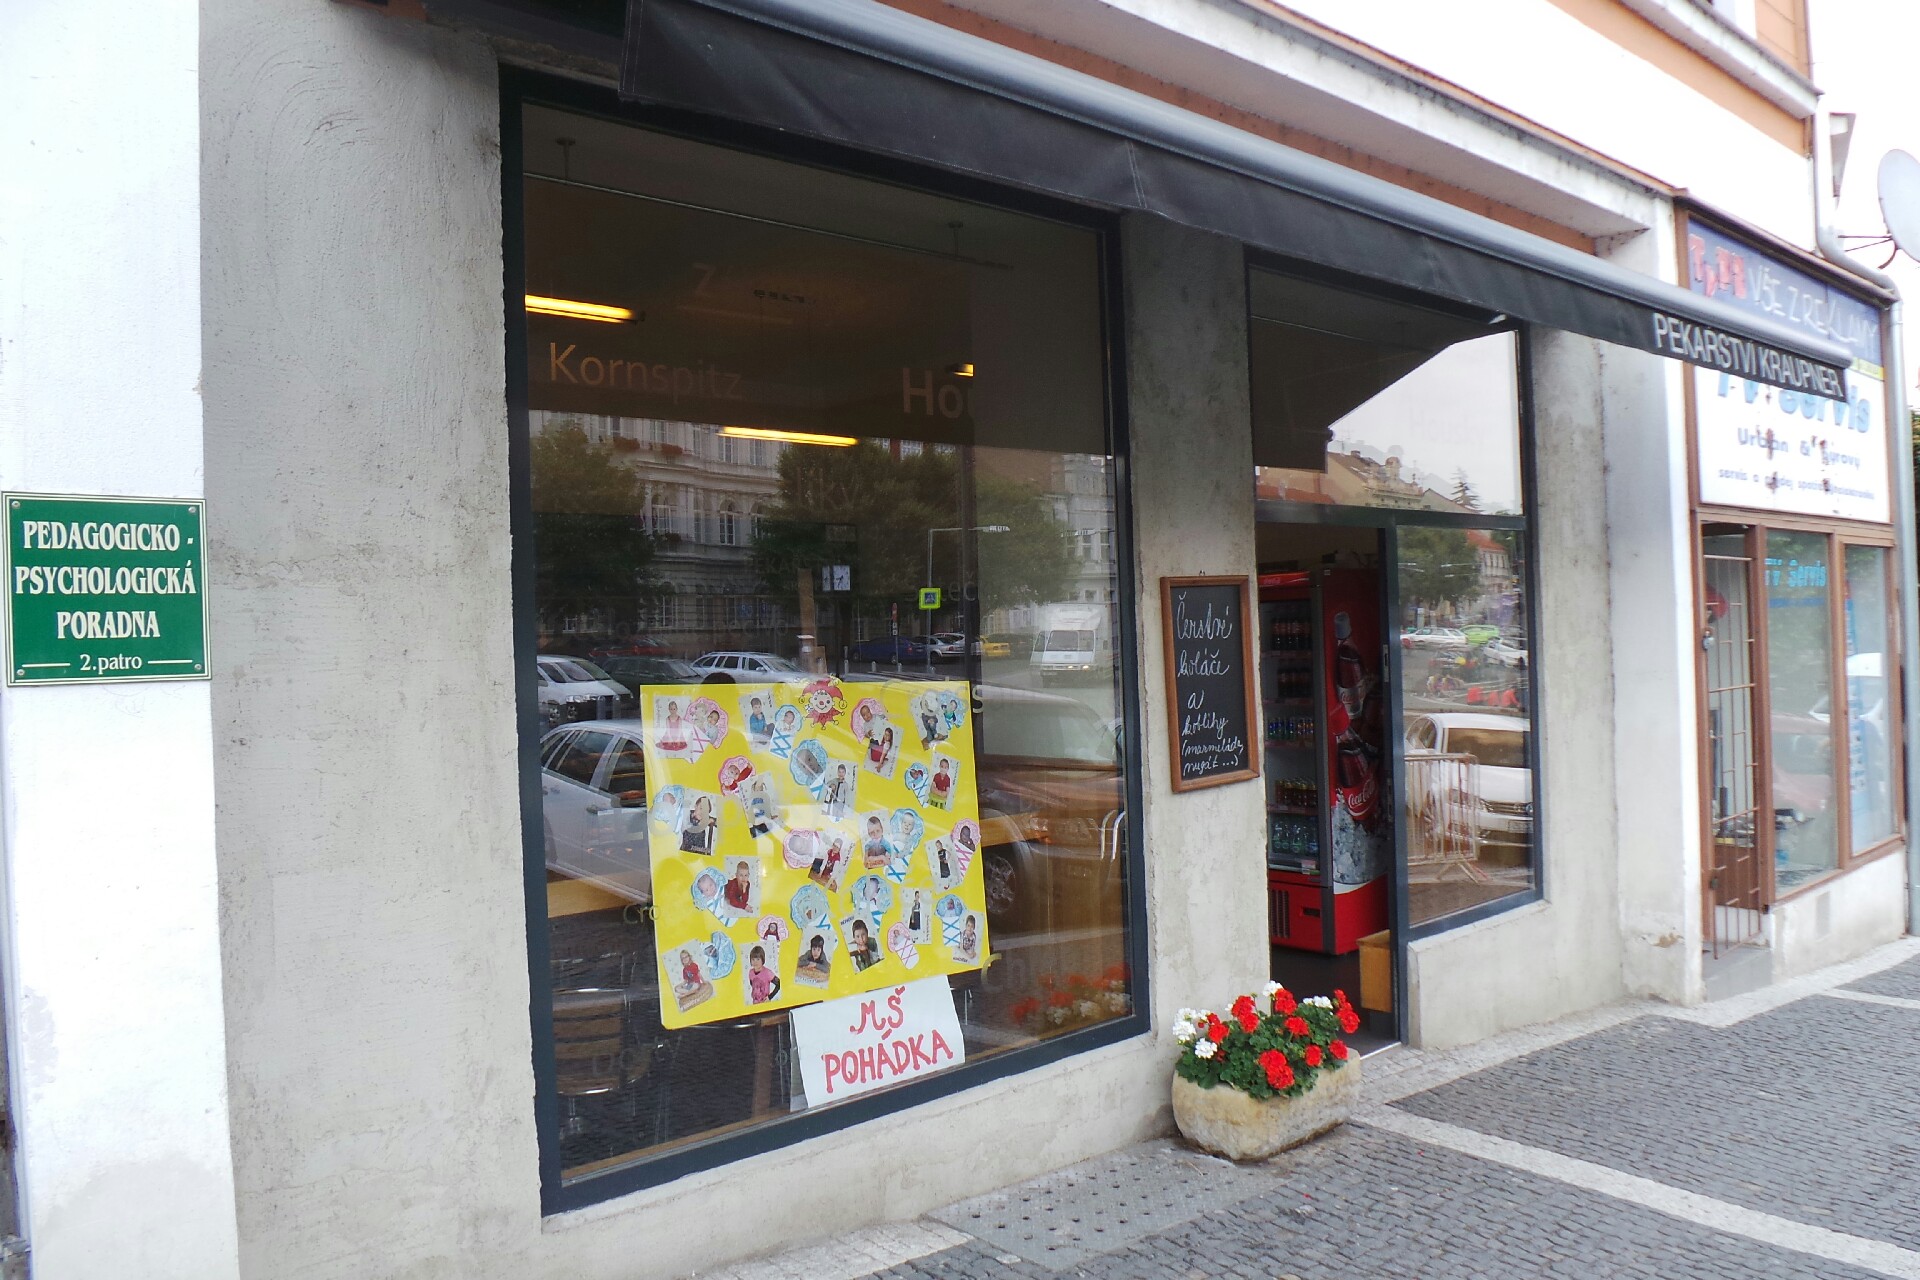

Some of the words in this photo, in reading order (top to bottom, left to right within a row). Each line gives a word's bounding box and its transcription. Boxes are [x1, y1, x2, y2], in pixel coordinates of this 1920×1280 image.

[549, 341, 744, 405] Kornspitz
[1758, 347, 1844, 398] KRAUPNER
[22, 520, 181, 552] PEDAGOGICKO
[15, 559, 197, 595] PSYCHOLOGICKÁ
[56, 610, 161, 640] PORADNA
[79, 653, 143, 675] 2.patro
[1177, 647, 1230, 678] koláče
[1187, 689, 1205, 710] a
[1181, 711, 1229, 740] koblihy
[821, 1028, 955, 1095] POHÁDKA
